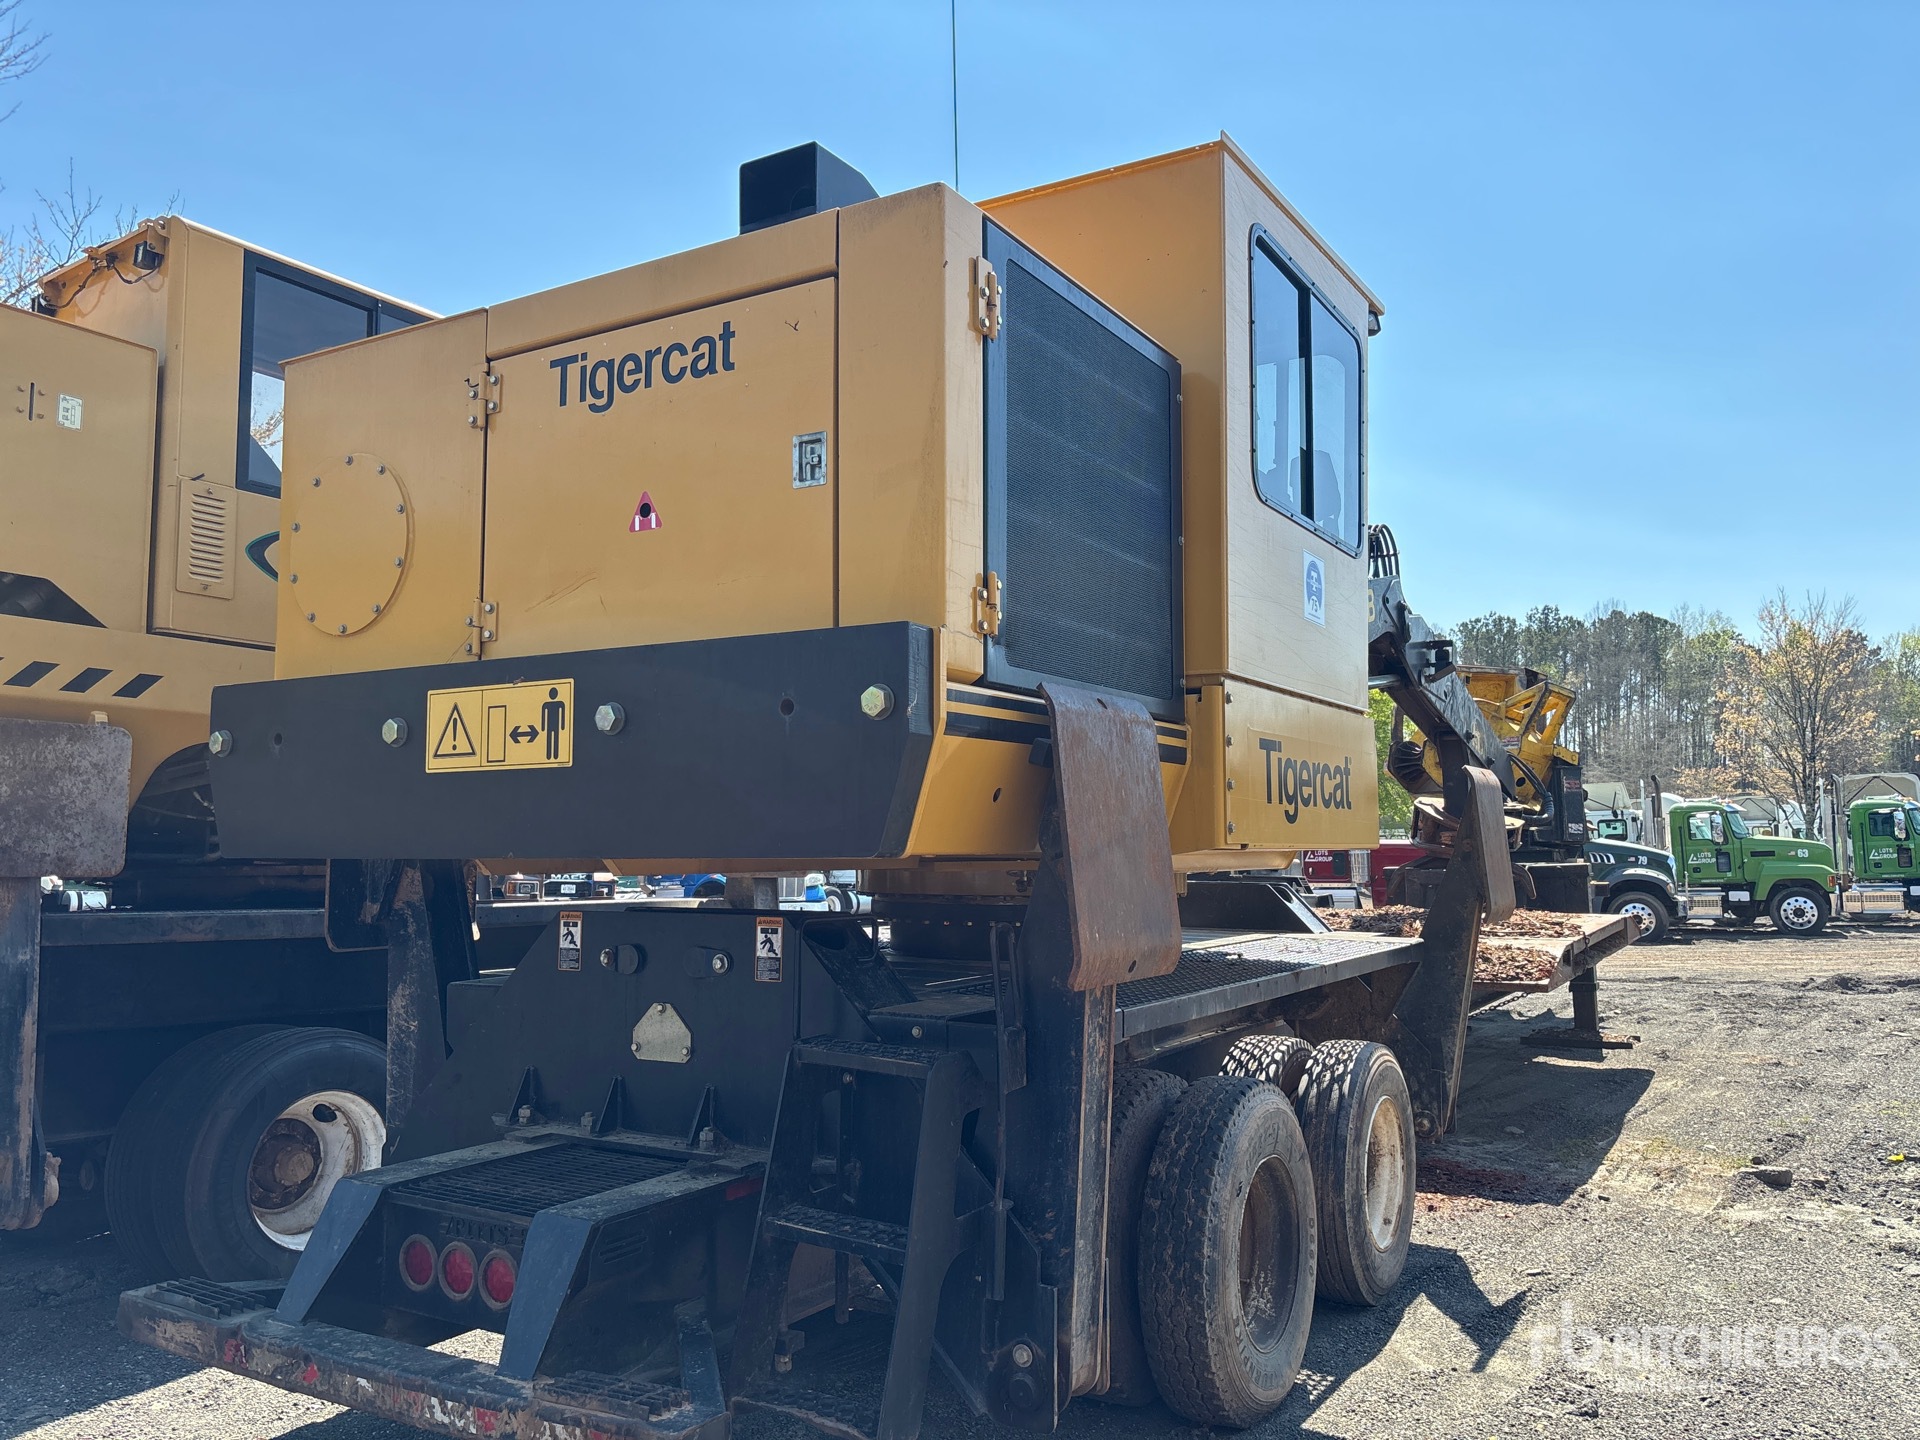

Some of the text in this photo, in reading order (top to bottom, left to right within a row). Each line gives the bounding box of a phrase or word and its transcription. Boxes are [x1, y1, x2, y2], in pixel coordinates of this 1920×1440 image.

[550, 320, 736, 414] Tigercat
[1258, 737, 1352, 824] Tigercat
[1637, 855, 1648, 865] 79
[1797, 848, 1809, 858] 63
